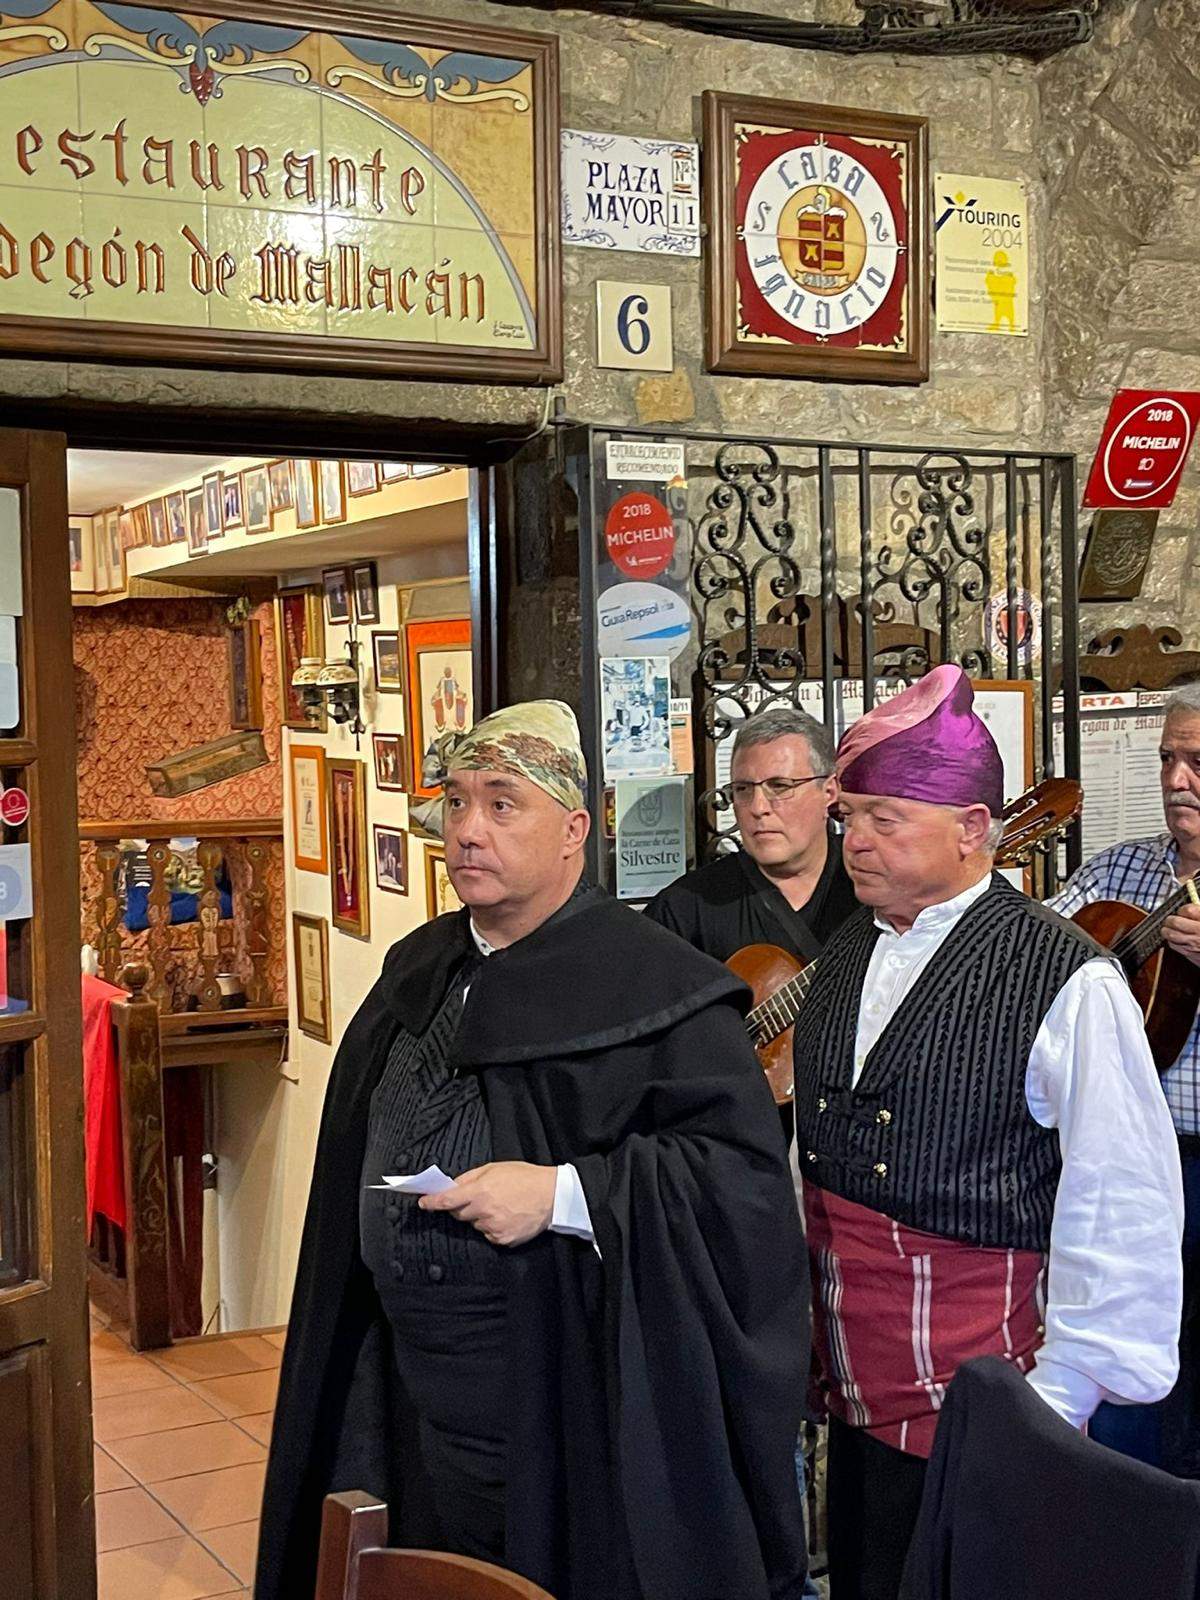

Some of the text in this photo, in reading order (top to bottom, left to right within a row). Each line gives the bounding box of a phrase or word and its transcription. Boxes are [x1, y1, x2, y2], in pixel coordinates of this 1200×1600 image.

[585, 161, 664, 195] PLAZA
[777, 151, 866, 197] Casa
[584, 192, 667, 229] MAYOR
[956, 208, 1022, 228] TOURING
[982, 228, 1023, 249] 2004
[181, 224, 237, 298] de
[250, 241, 486, 324] Mallacán
[617, 294, 650, 355] 6
[1147, 408, 1174, 422] 2018
[1122, 435, 1181, 450] MICHELIN
[623, 503, 652, 519] 2018
[607, 526, 674, 547] MICHELIN
[620, 850, 680, 868] Silvestre
